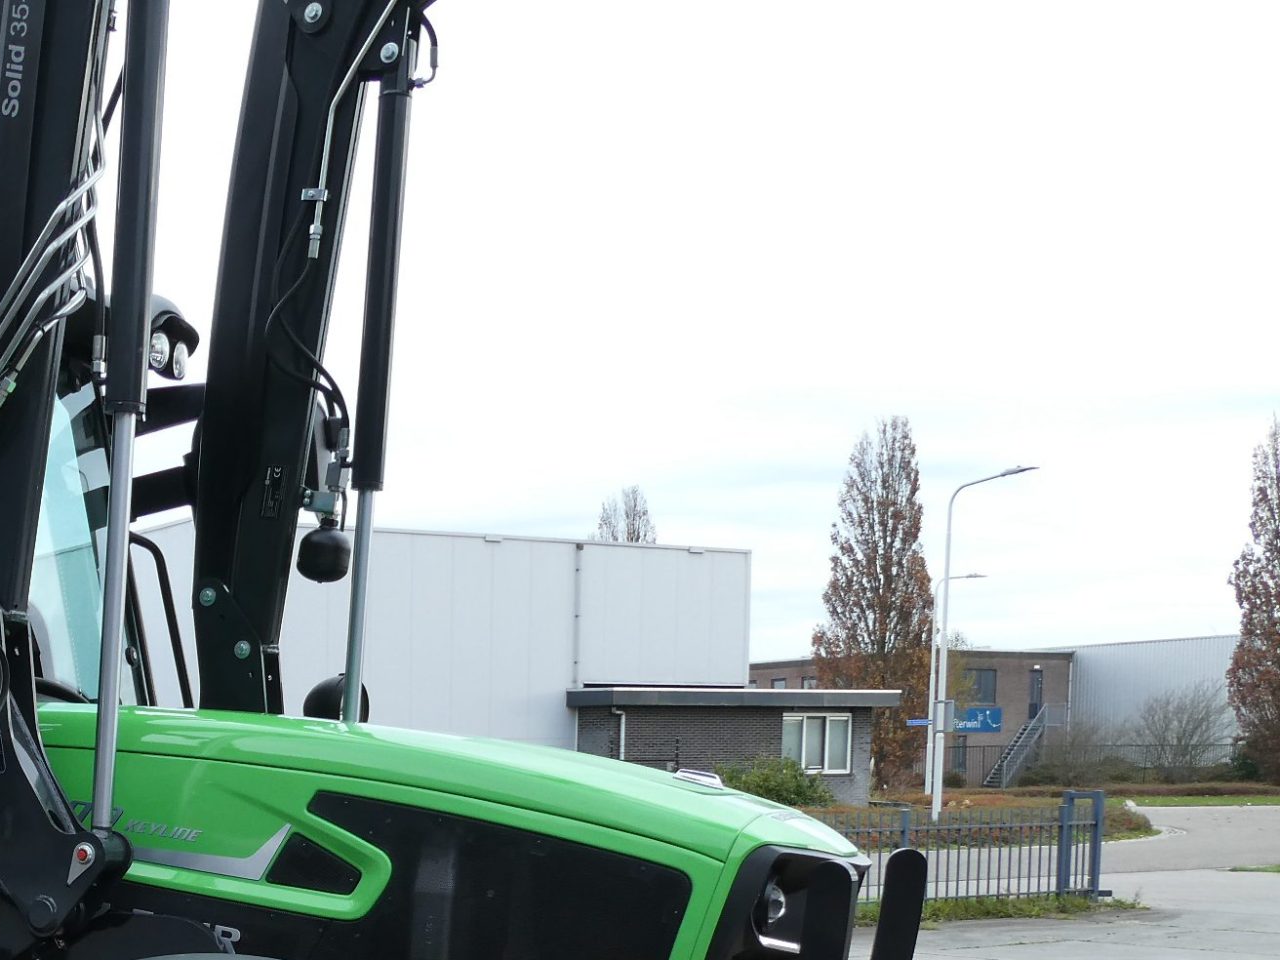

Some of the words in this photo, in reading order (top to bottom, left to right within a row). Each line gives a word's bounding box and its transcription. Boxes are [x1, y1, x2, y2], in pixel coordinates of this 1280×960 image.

[10, 0, 30, 37] 35
[1, 44, 25, 118] Solid
[124, 819, 204, 842] KEYLINE
